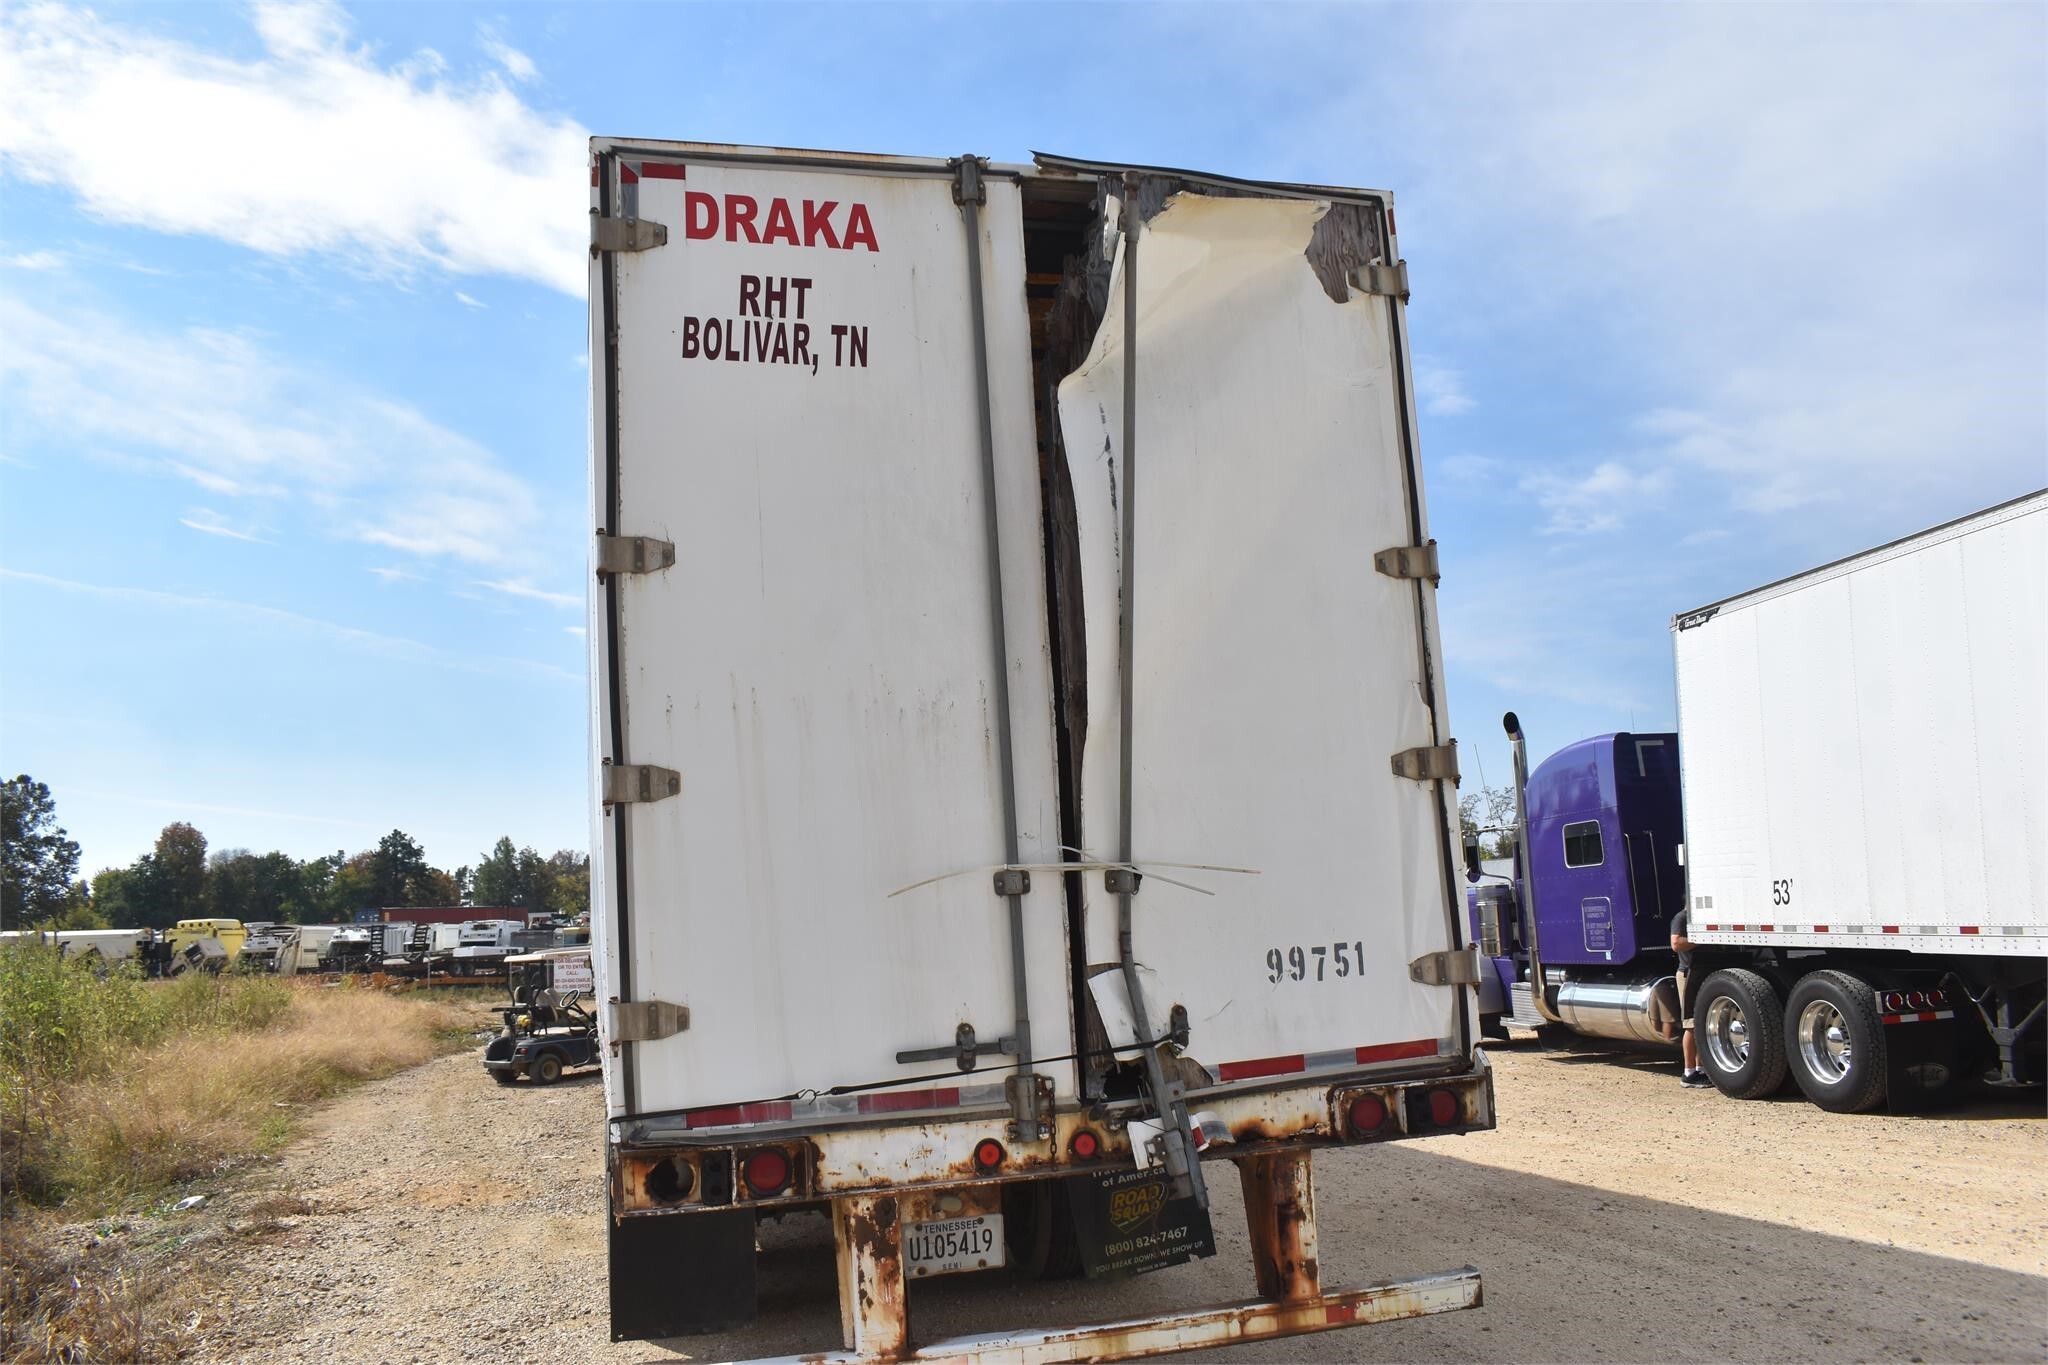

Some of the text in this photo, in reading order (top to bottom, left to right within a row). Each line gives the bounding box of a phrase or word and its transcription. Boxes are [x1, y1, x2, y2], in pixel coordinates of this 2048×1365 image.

[685, 191, 880, 252] DRAKA
[739, 274, 813, 320] RHT
[682, 316, 868, 376] BOLIVAR, TN
[1773, 878, 1794, 906] 53'
[1266, 941, 1365, 984] 99751
[1102, 1177, 1114, 1187] of
[1114, 1185, 1161, 1208] ROAD
[1114, 1200, 1160, 1220] SQUAD
[924, 1219, 978, 1234] TENNESSEE
[909, 1229, 993, 1262] U105419
[1105, 1226, 1187, 1256] (800) 824-7467
[1160, 1247, 1171, 1257] WE
[1172, 1243, 1193, 1254] SHOW
[942, 1262, 962, 1270] SEMI
